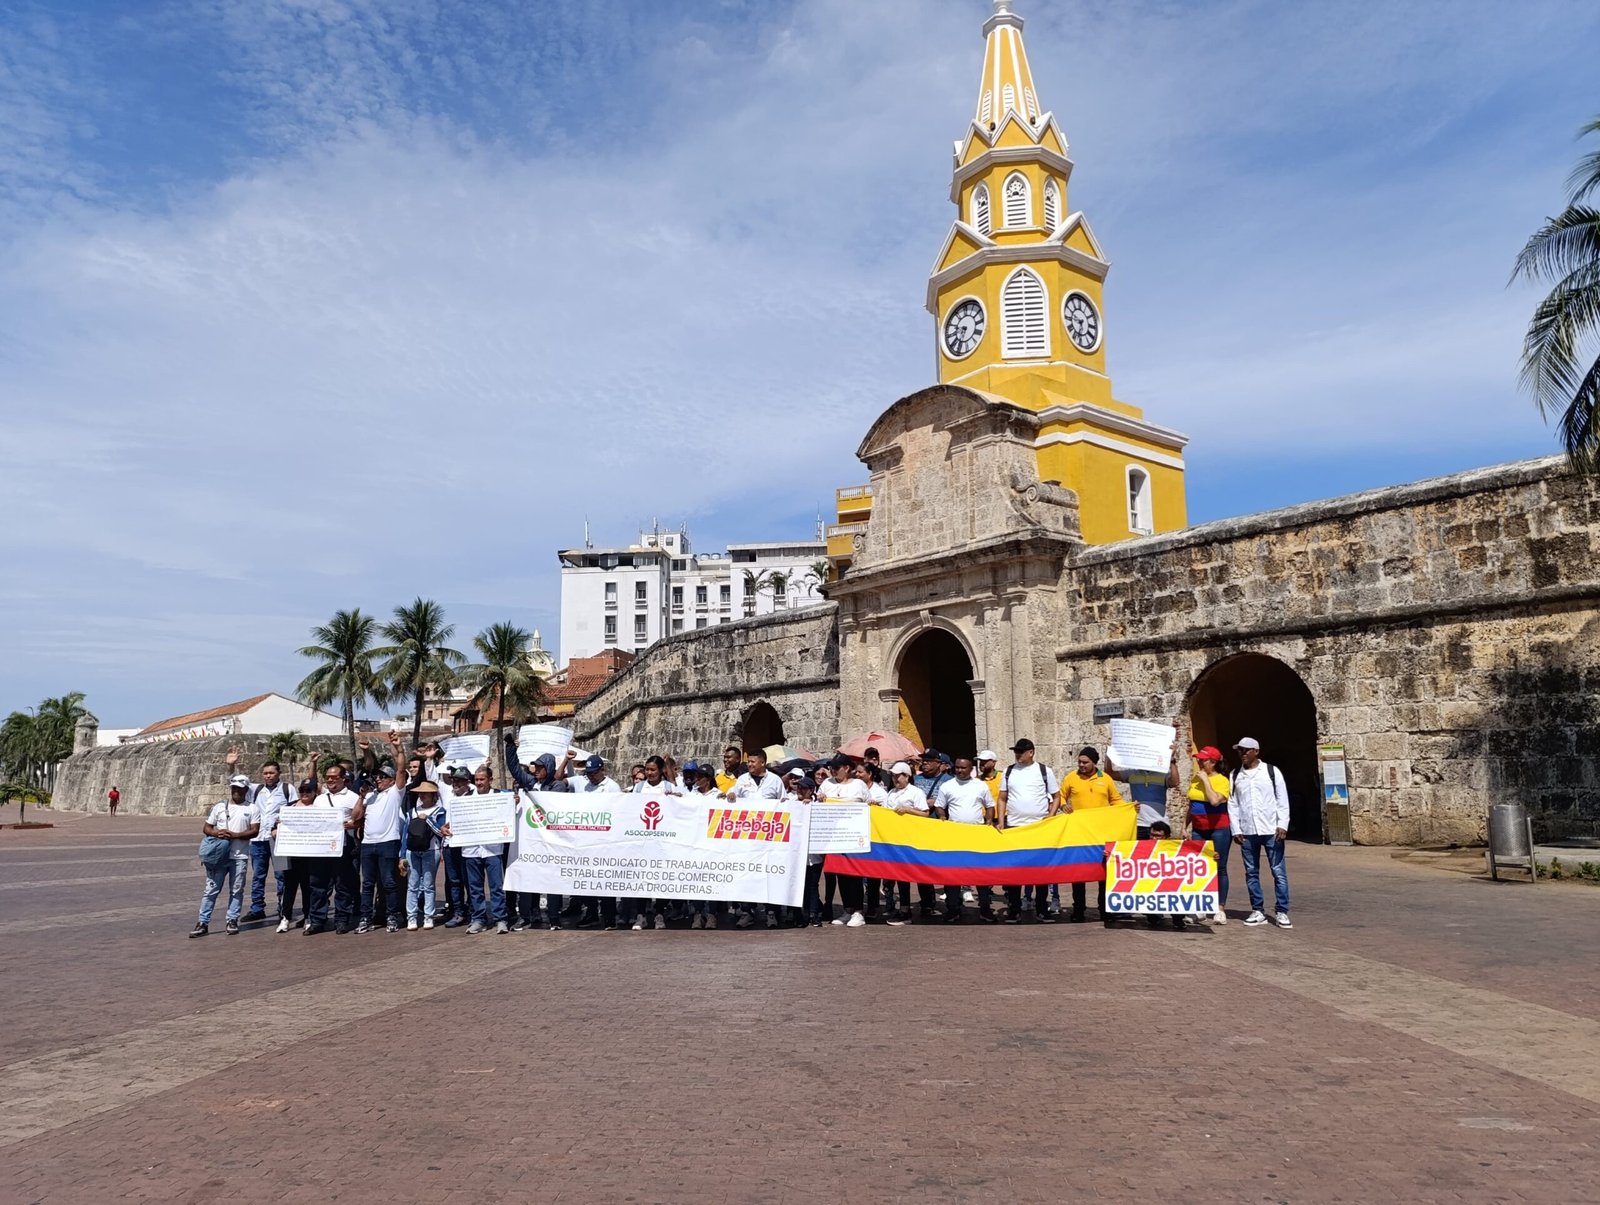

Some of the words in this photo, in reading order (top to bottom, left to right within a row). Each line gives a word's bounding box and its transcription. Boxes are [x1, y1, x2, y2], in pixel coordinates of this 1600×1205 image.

[624, 829, 677, 838] ASOCOPSERVIR
[592, 857, 648, 868] SINDICATO
[650, 859, 663, 868] DE
[665, 860, 746, 872] TRABAJADORES
[748, 862, 763, 873] DE
[765, 864, 786, 875] LOS
[560, 867, 660, 881] ESTABLECIMIENTOS
[661, 871, 676, 881] DE
[678, 872, 734, 883] COMERCIO
[573, 880, 587, 890] DE
[590, 881, 603, 891] LA
[604, 882, 645, 892] REBAJA
